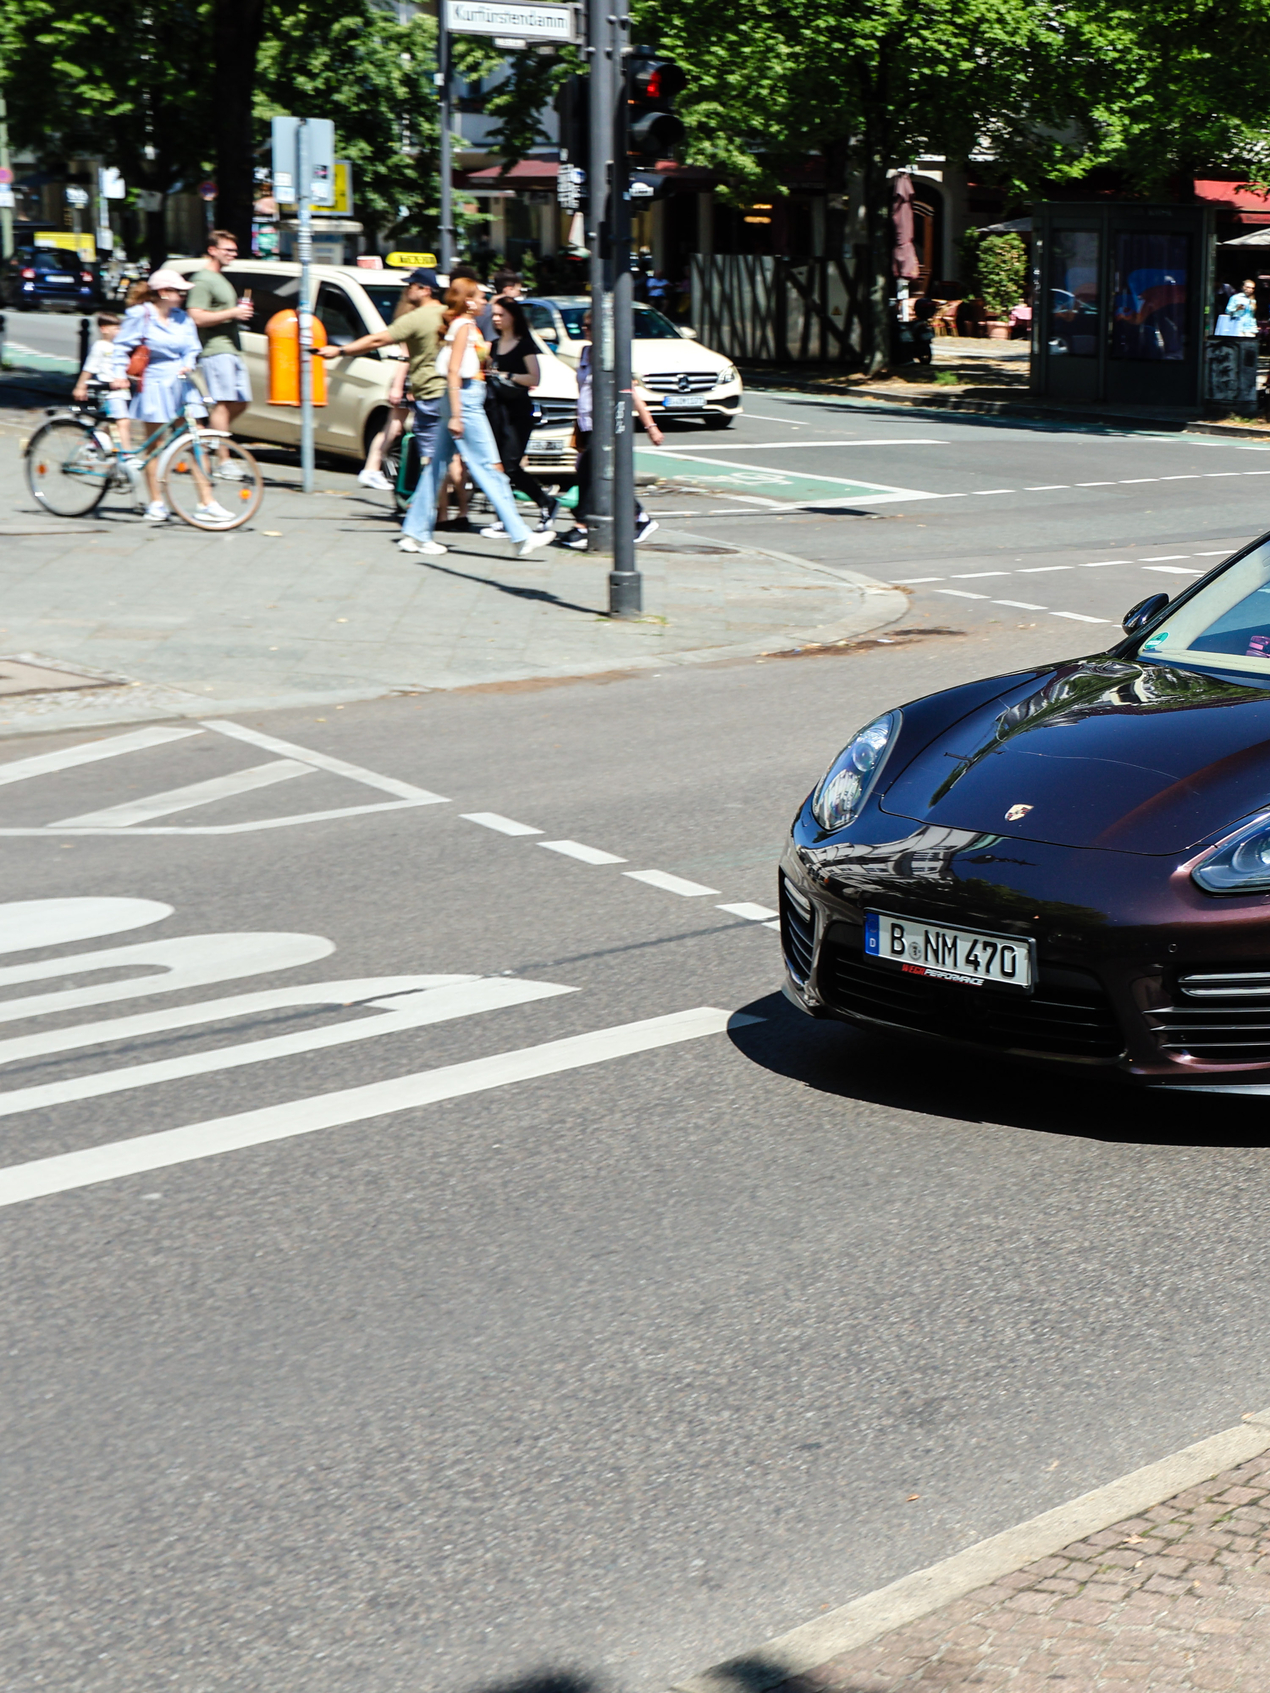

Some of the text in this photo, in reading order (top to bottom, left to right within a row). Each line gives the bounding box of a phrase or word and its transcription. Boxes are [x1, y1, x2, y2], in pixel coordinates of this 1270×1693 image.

[452, 4, 568, 29] Kurfürstendamm
[869, 922, 1018, 978] D B NM 470
